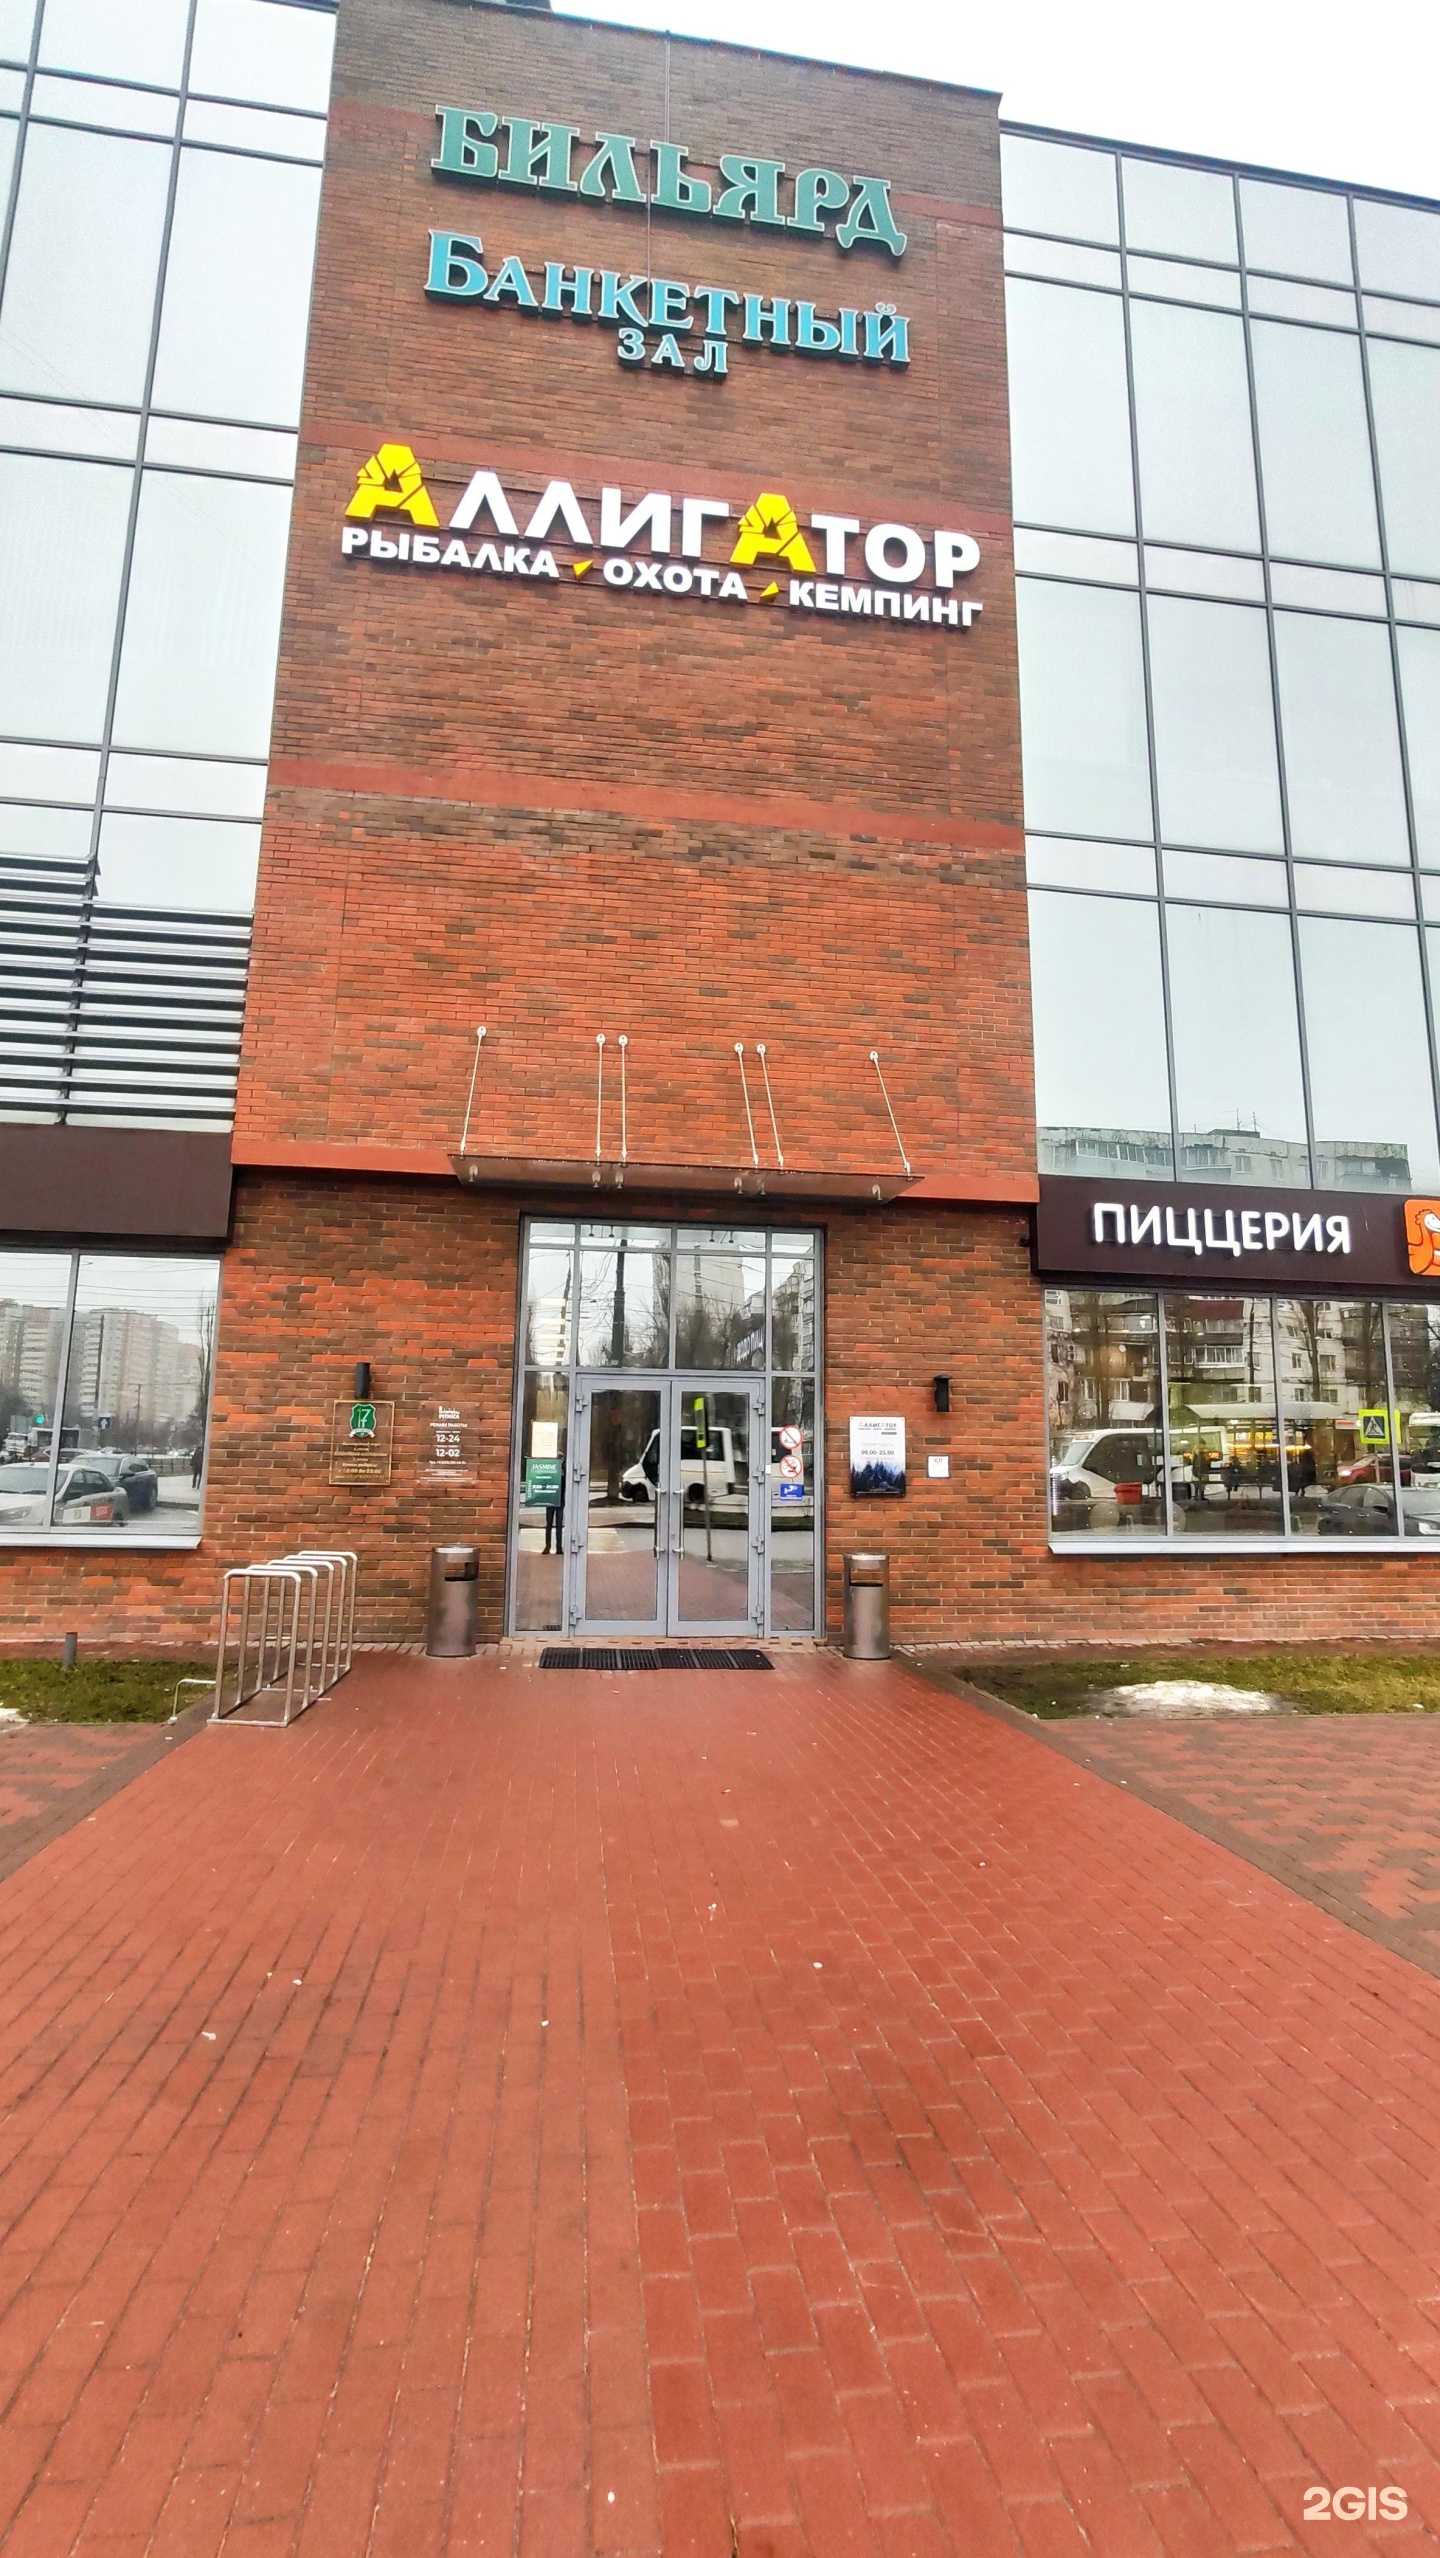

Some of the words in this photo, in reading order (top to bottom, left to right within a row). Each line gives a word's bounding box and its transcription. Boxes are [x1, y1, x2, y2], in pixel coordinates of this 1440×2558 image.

[431, 104, 908, 257] БИЛЬЯРД
[424, 229, 911, 363] БАНКЕТНЫЙ
[617, 326, 729, 375] ЗАЛ
[344, 443, 981, 589] АЛЛИГАТОР
[341, 526, 561, 579] РЫБАЛКА
[602, 557, 748, 601] ОХОТА
[788, 579, 984, 627] КЕМПИНГ
[1093, 1202, 1352, 1258] ПИЦЦЕРИЯ
[435, 1433, 461, 1443] 12-24
[435, 1448, 461, 1458] 12-02
